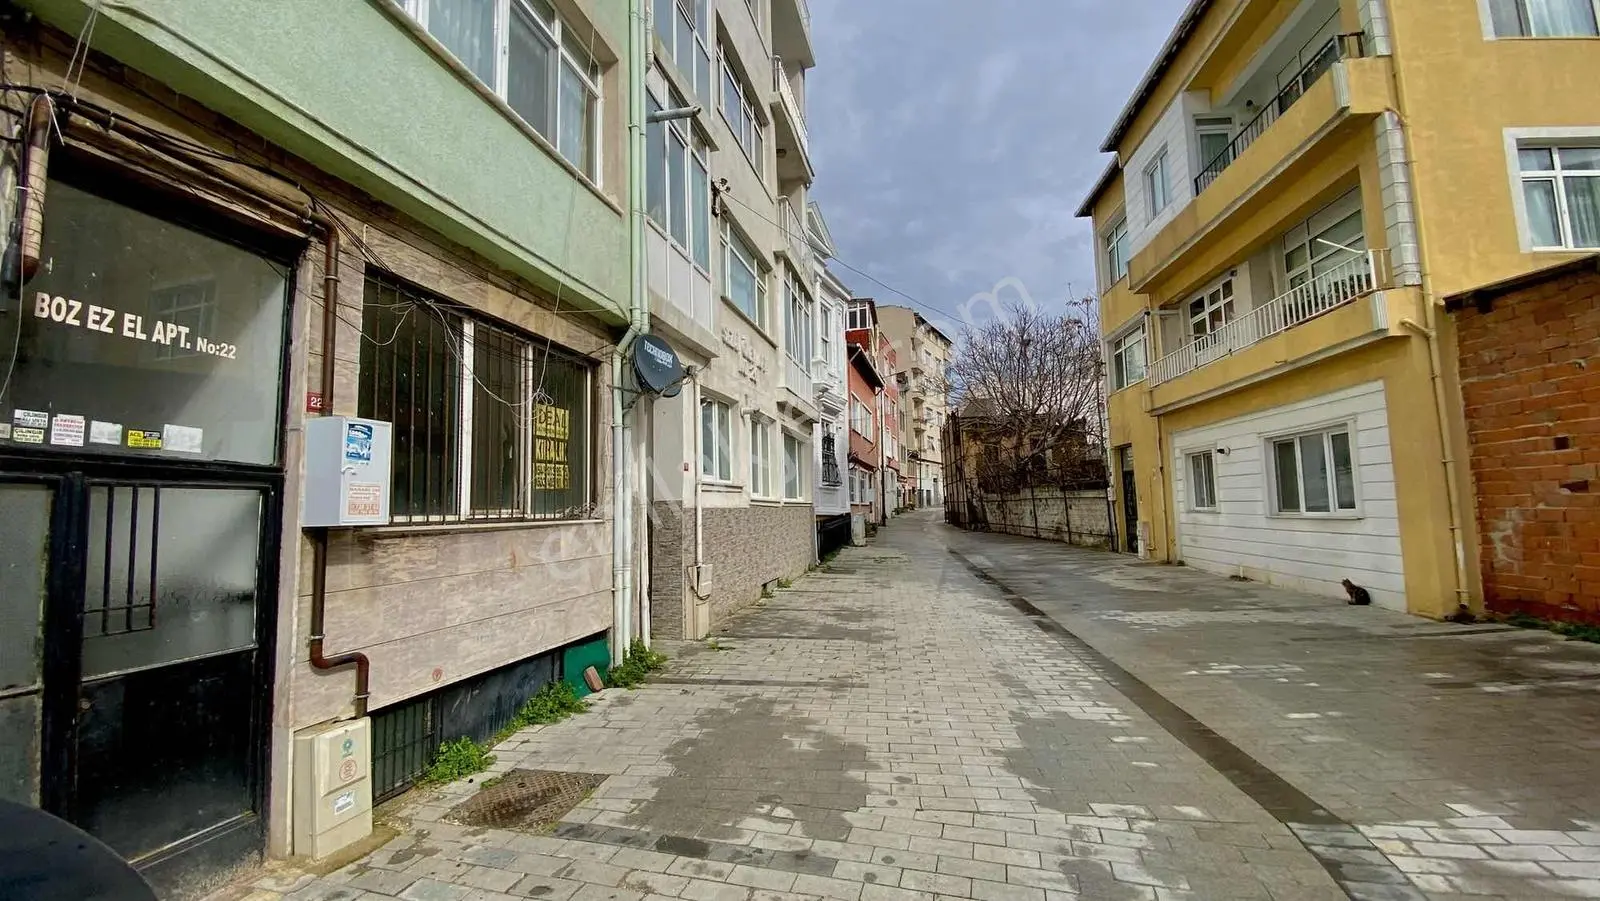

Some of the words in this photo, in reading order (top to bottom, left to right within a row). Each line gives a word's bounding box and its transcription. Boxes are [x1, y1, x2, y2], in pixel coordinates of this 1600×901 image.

[34, 291, 82, 326] BOZ
[86, 305, 115, 334] EZ
[122, 313, 147, 340] EL
[152, 320, 191, 349] APT.
[196, 337, 236, 359] No:22
[310, 396, 322, 407] 22
